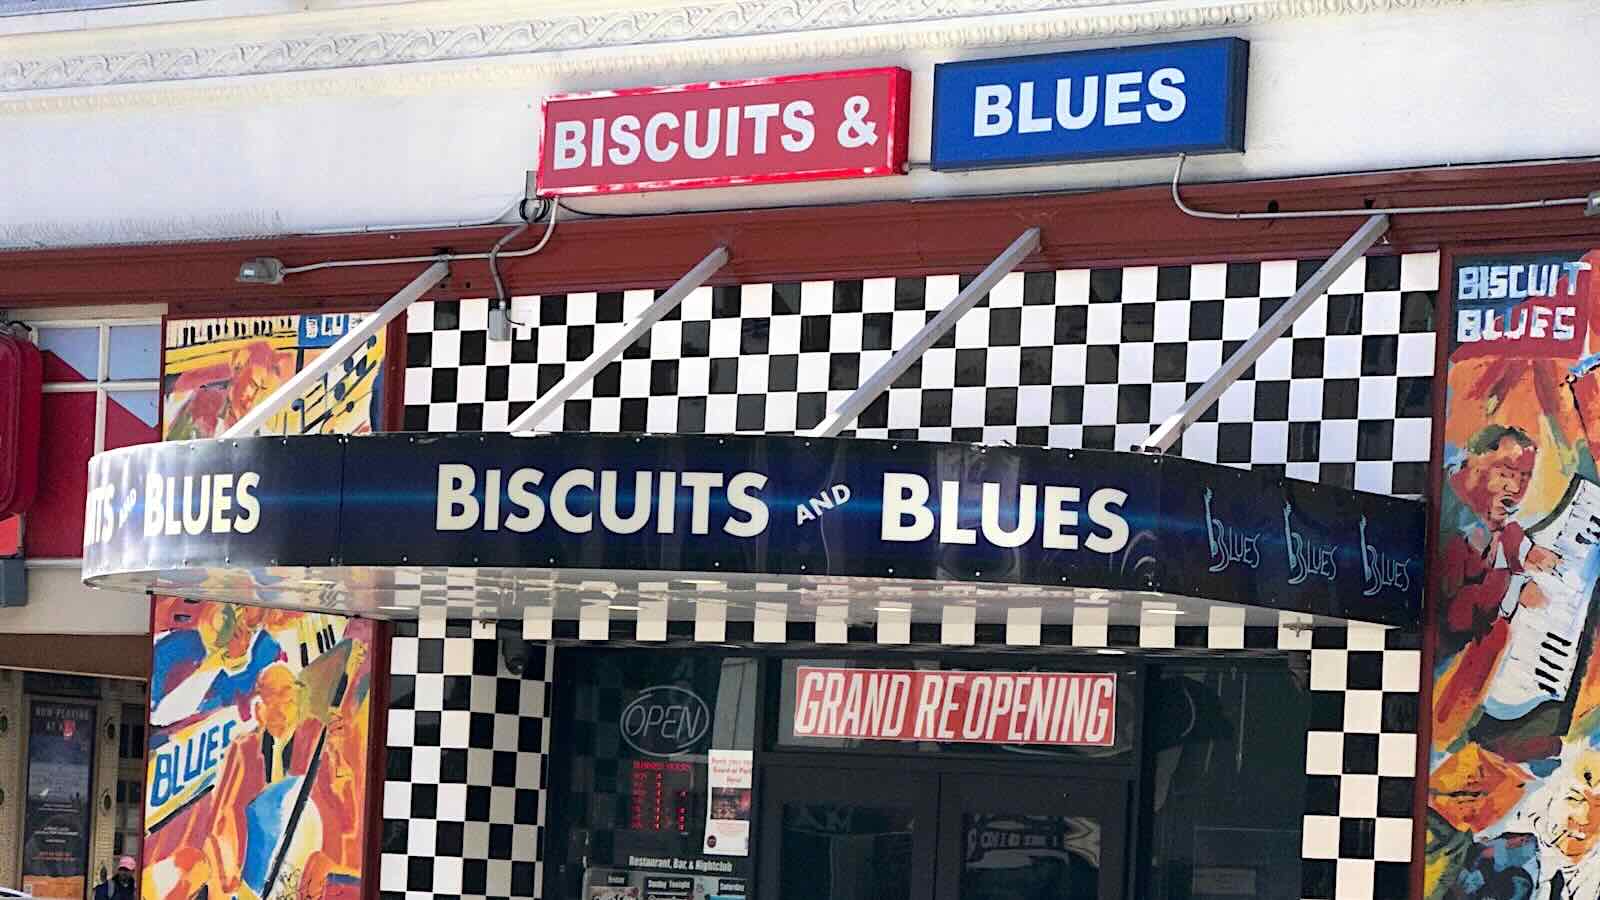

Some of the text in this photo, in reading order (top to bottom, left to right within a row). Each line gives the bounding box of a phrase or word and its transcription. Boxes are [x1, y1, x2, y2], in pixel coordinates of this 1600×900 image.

[552, 95, 878, 170] BISCUITS &
[973, 67, 1187, 137] BLUES
[1458, 261, 1592, 299] BISCUIT
[1456, 305, 1576, 342] BLUES
[143, 471, 261, 537] BLUES
[435, 463, 1130, 555] BISCUITS AND BLUES
[1202, 487, 1261, 573] BLUES
[1283, 500, 1339, 585] BLUES
[1359, 513, 1412, 597] BLUES
[625, 704, 702, 740] OPEN
[794, 671, 1114, 744] GRAND RE OPENING
[628, 855, 672, 869] Restaurant,
[695, 859, 733, 872] Nightclub
